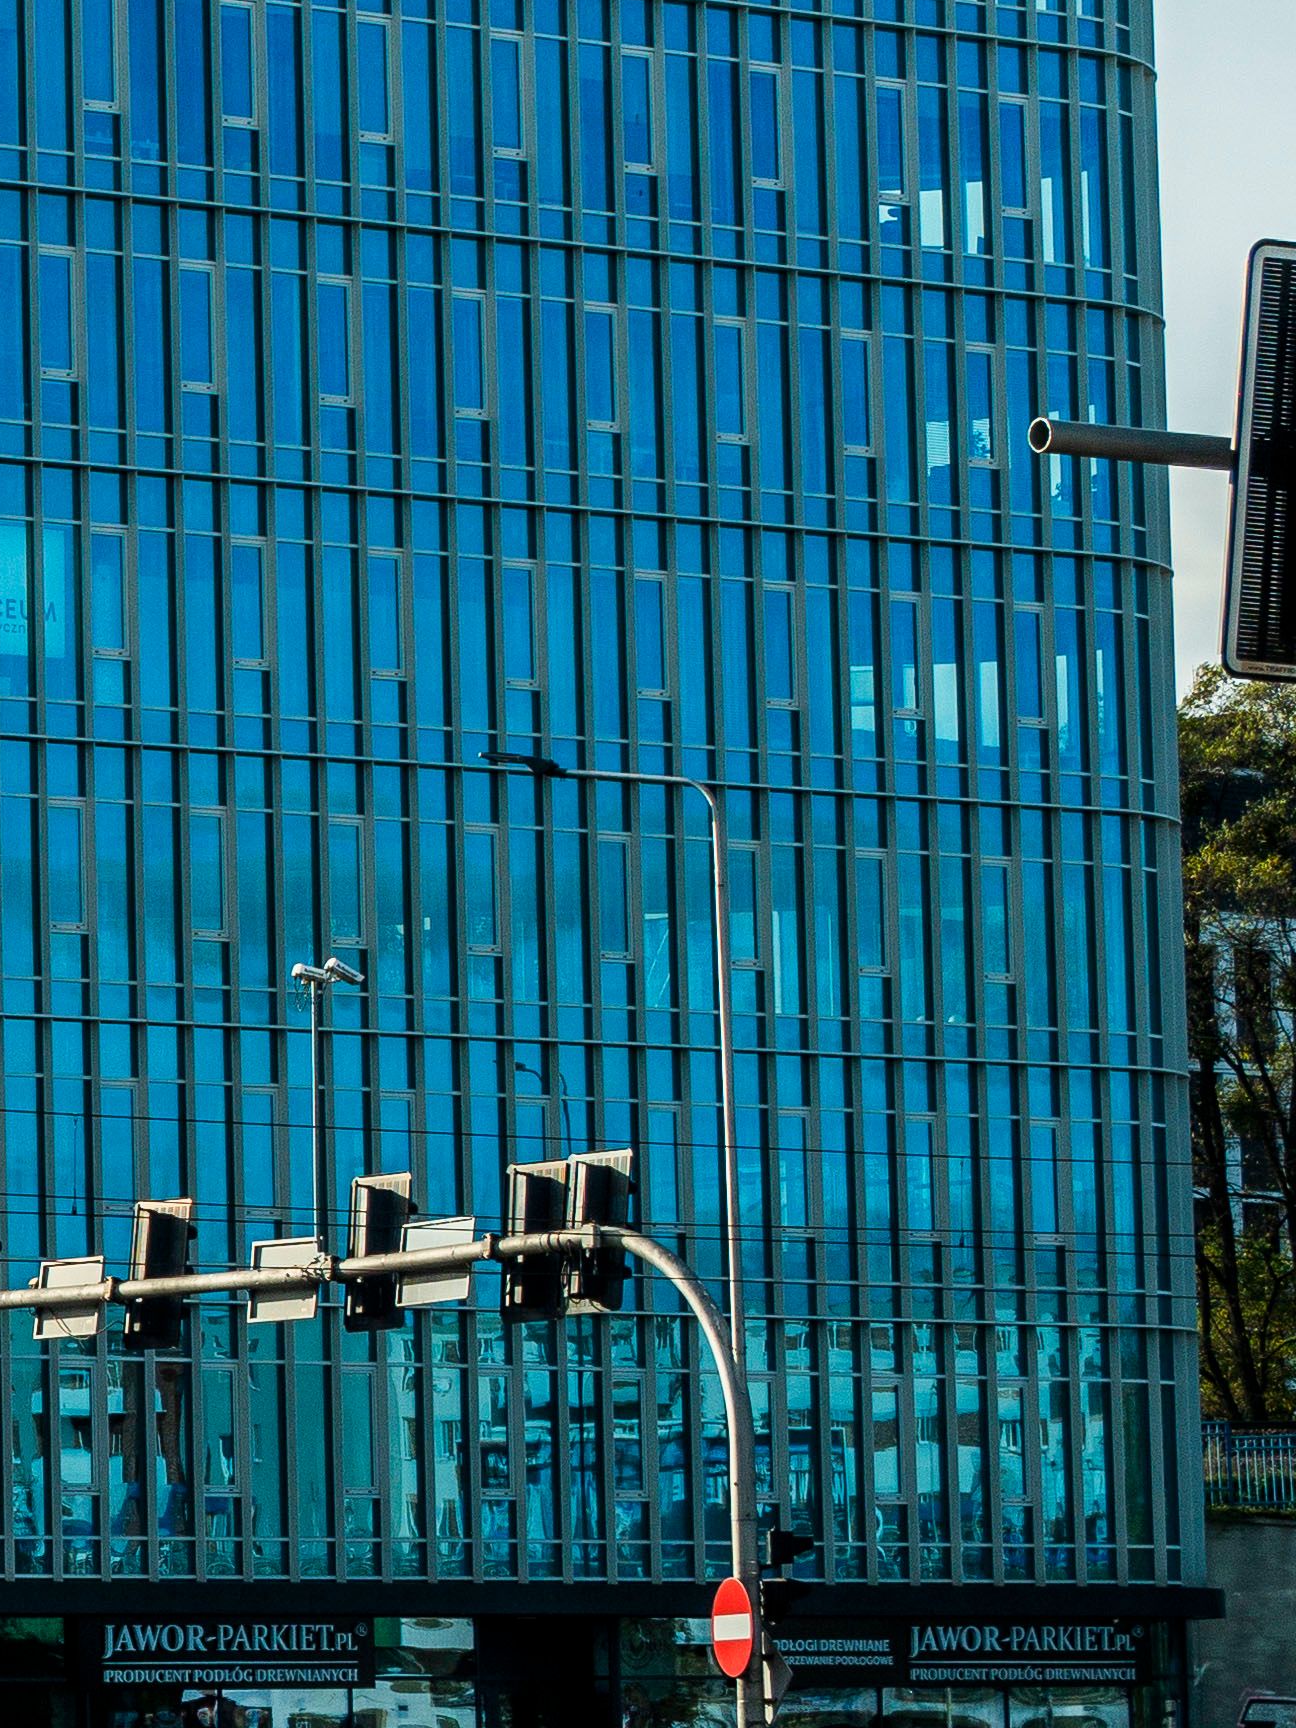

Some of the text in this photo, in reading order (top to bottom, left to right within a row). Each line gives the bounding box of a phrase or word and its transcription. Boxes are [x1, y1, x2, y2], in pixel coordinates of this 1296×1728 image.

[820, 1640, 890, 1652] DREWNIANE
[783, 1655, 894, 1666] GRZEWANIE PODŁOGOWE
[103, 1666, 358, 1683] PRODUCENT PODŁÓG DREWNIANYCH
[910, 1666, 1136, 1681] PRODUCENT PODŁÓG DREWNIANYCH
